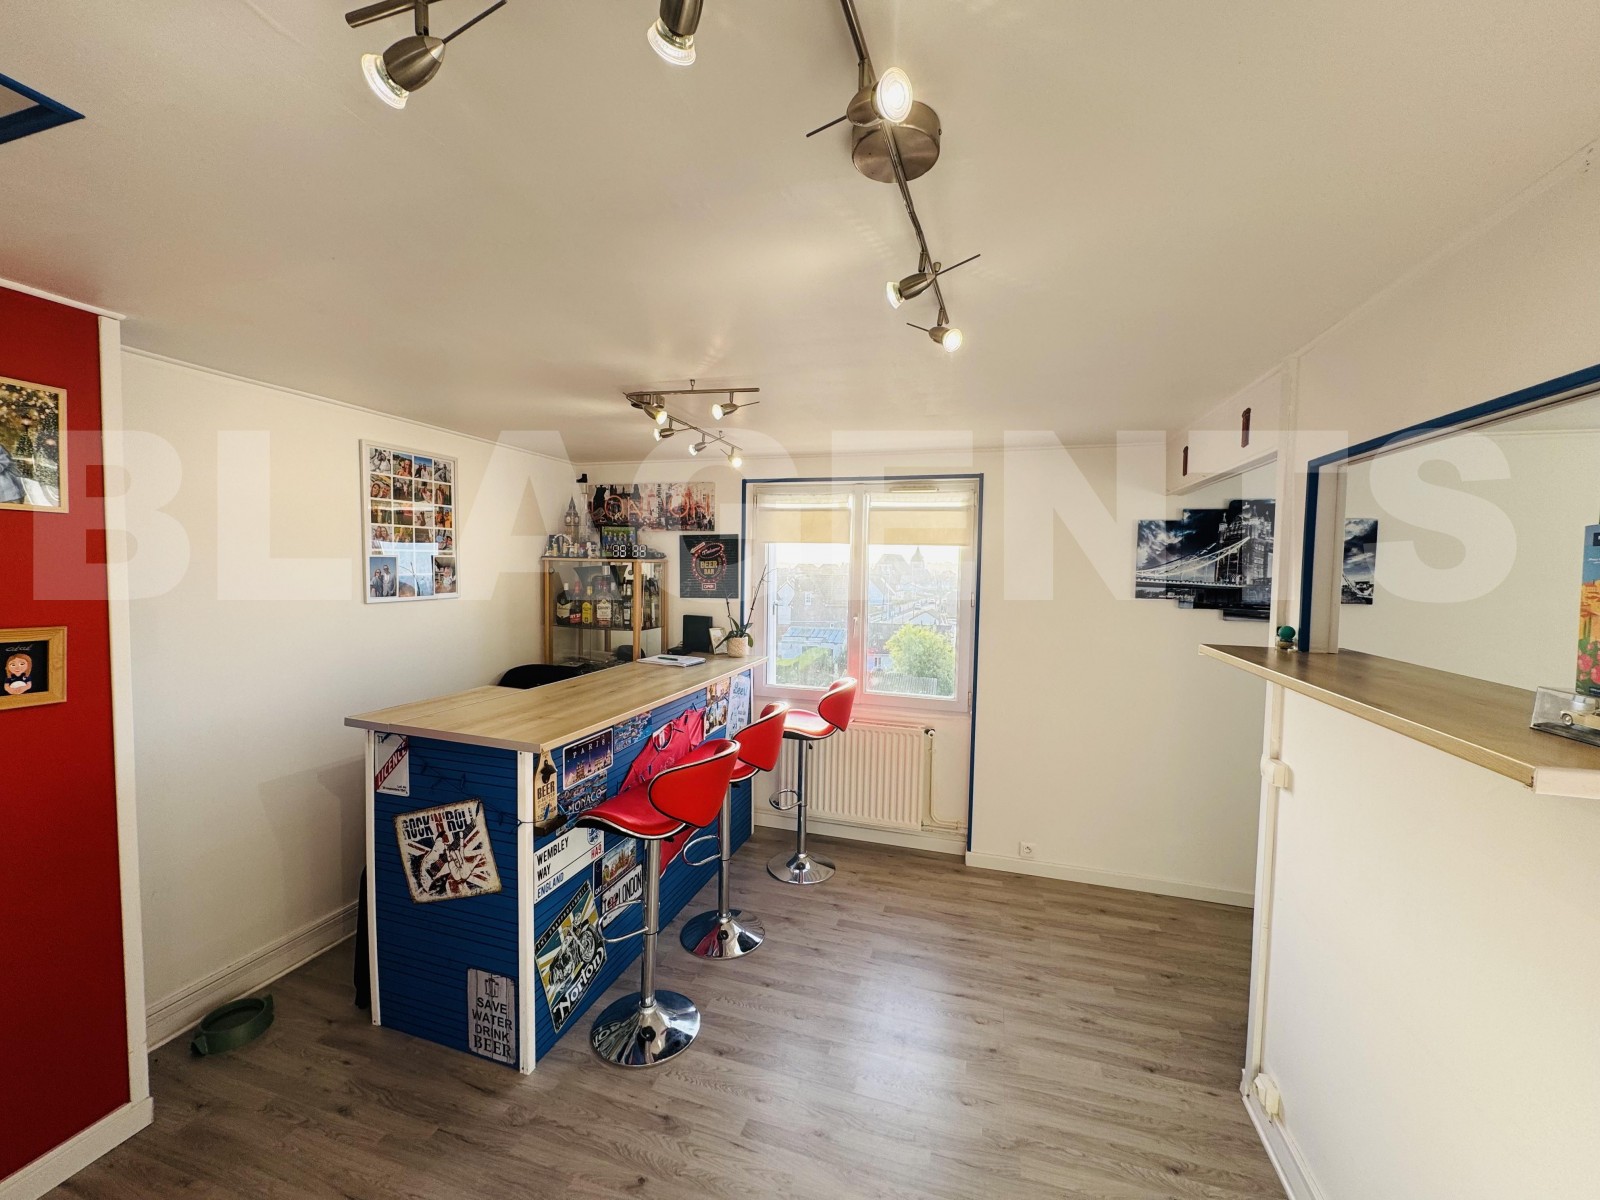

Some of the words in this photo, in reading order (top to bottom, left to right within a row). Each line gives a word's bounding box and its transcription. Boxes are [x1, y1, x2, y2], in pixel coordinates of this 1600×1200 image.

[700, 560, 718, 569] BEER
[572, 739, 605, 759] PARIS
[537, 780, 555, 800] BEER
[568, 788, 607, 813] MONACO
[536, 836, 569, 867] WEMBLEY
[537, 863, 551, 882] WAY
[537, 872, 564, 899] ENGLAND
[618, 869, 642, 905] LONDON
[552, 946, 604, 1021] Norton
[476, 997, 508, 1015] SAVE
[472, 1008, 513, 1031] WATER
[474, 1023, 510, 1044] DRINK
[473, 1034, 512, 1059] BEER
